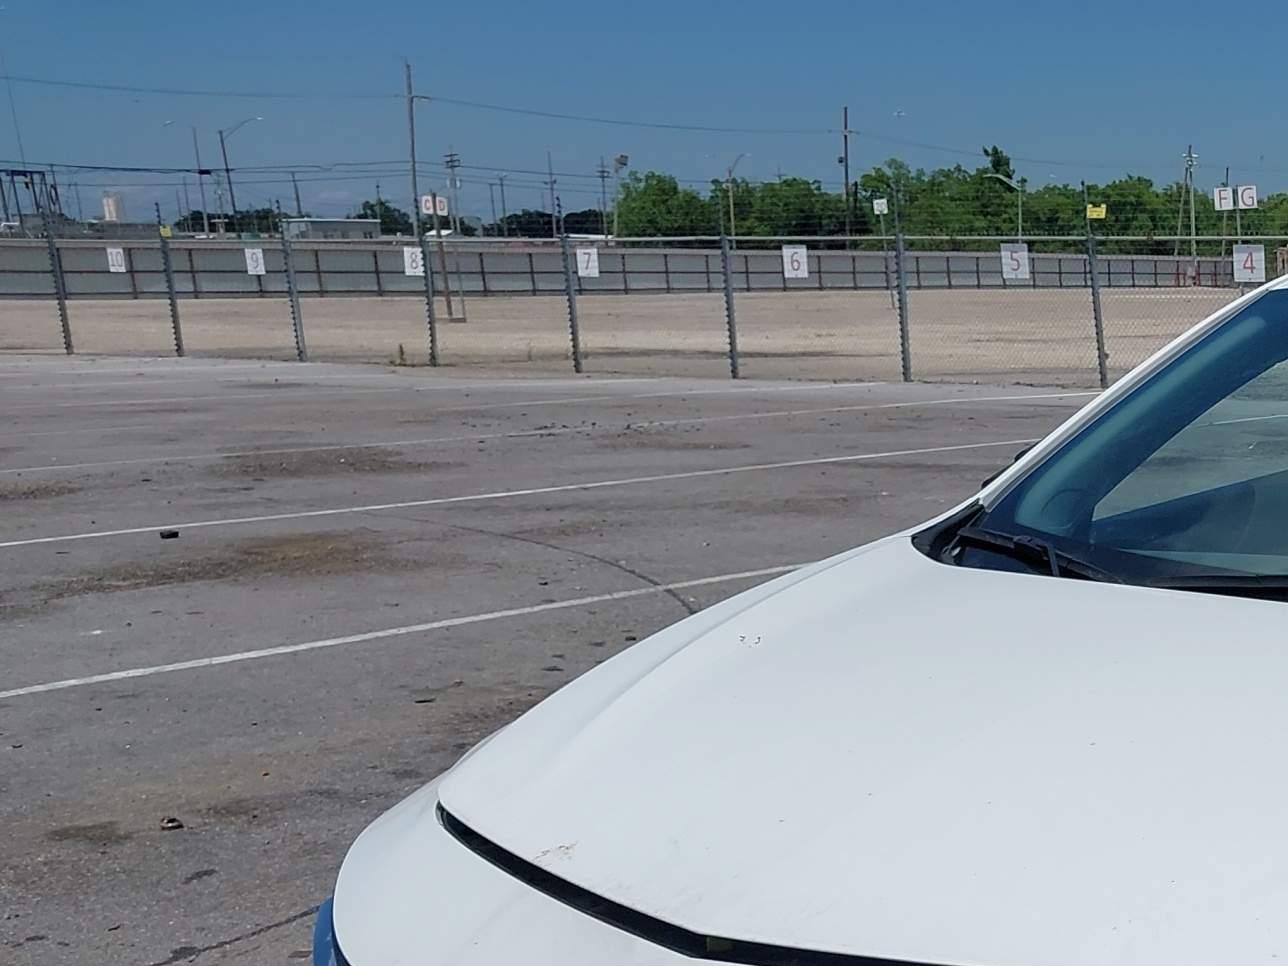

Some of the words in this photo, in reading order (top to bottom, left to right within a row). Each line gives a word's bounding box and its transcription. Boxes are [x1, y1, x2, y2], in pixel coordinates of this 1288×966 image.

[1218, 188, 1228, 208] F
[1241, 187, 1255, 207] G
[109, 251, 124, 268] 10
[249, 252, 260, 270] 9
[410, 252, 419, 270] 8
[583, 252, 592, 270] 7
[790, 251, 801, 271] 6
[1010, 251, 1020, 271] 5
[1243, 251, 1256, 274] 4
